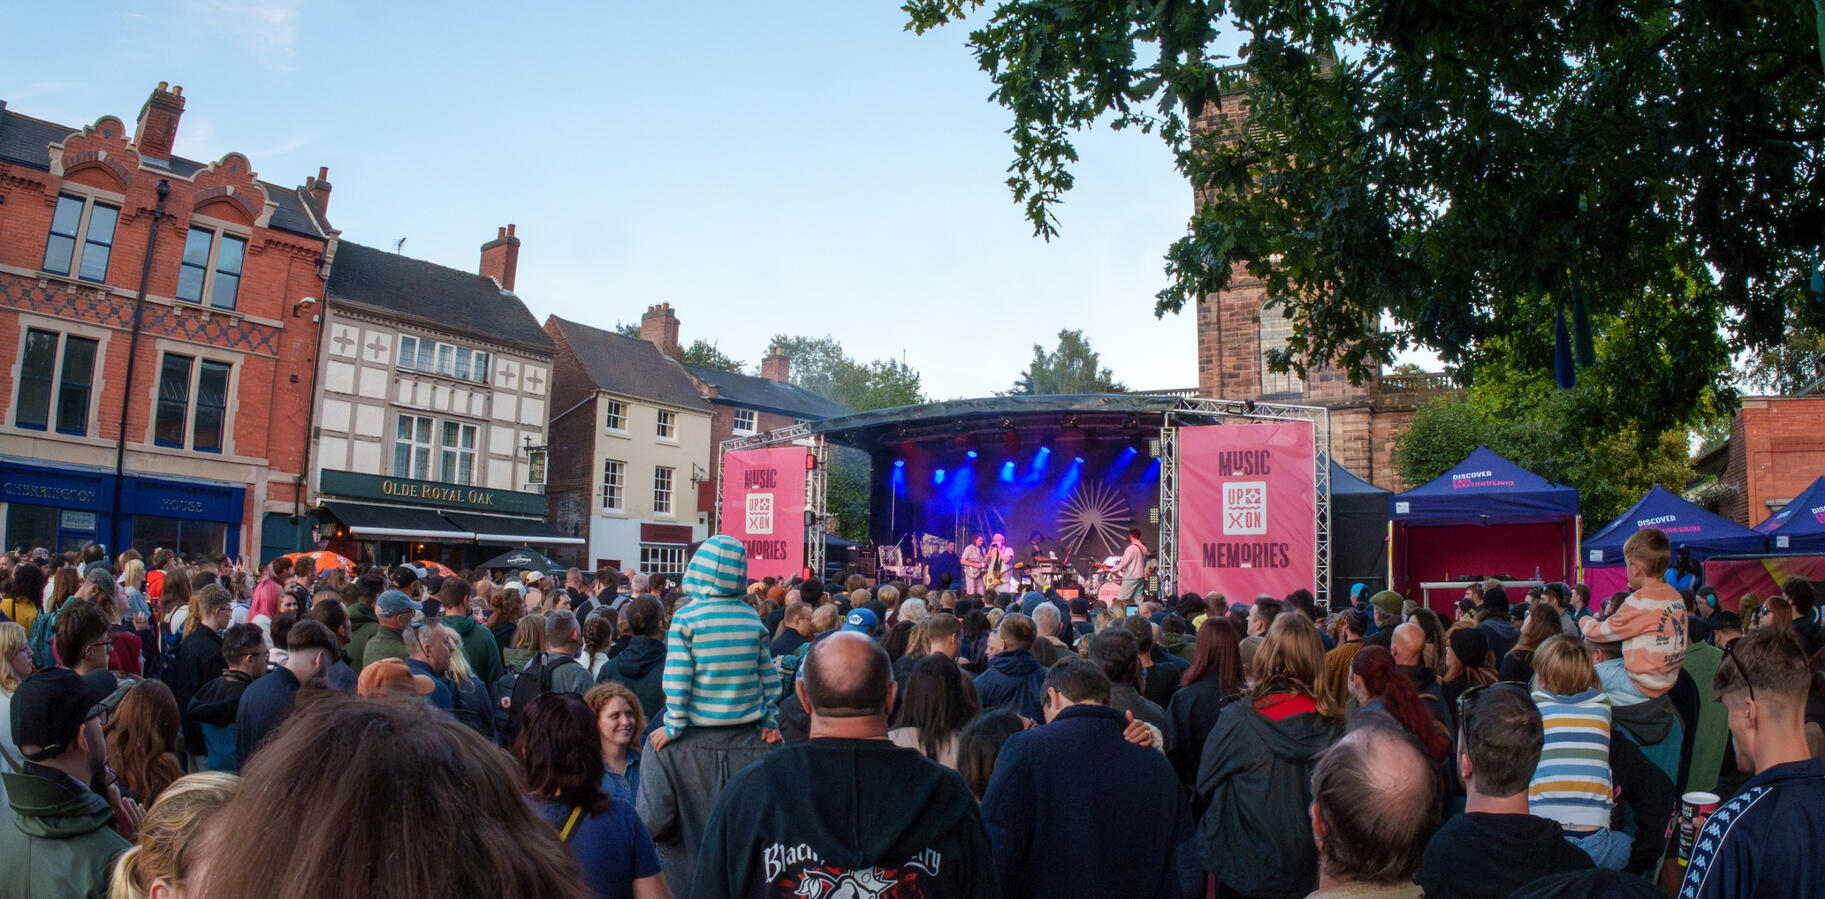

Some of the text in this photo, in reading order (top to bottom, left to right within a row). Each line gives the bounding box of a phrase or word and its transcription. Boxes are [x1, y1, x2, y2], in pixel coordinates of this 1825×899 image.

[1218, 450, 1271, 477] MUSIC
[744, 468, 777, 489] MUSIC
[1452, 470, 1493, 481] DISCOVER
[383, 480, 494, 505] OLDE ROYAL OAK
[1228, 488, 1244, 505] UP
[749, 498, 760, 511] UP
[1637, 514, 1677, 527] DISCOVER
[742, 540, 787, 561] MORIES
[1202, 542, 1290, 569] MEMORIES
